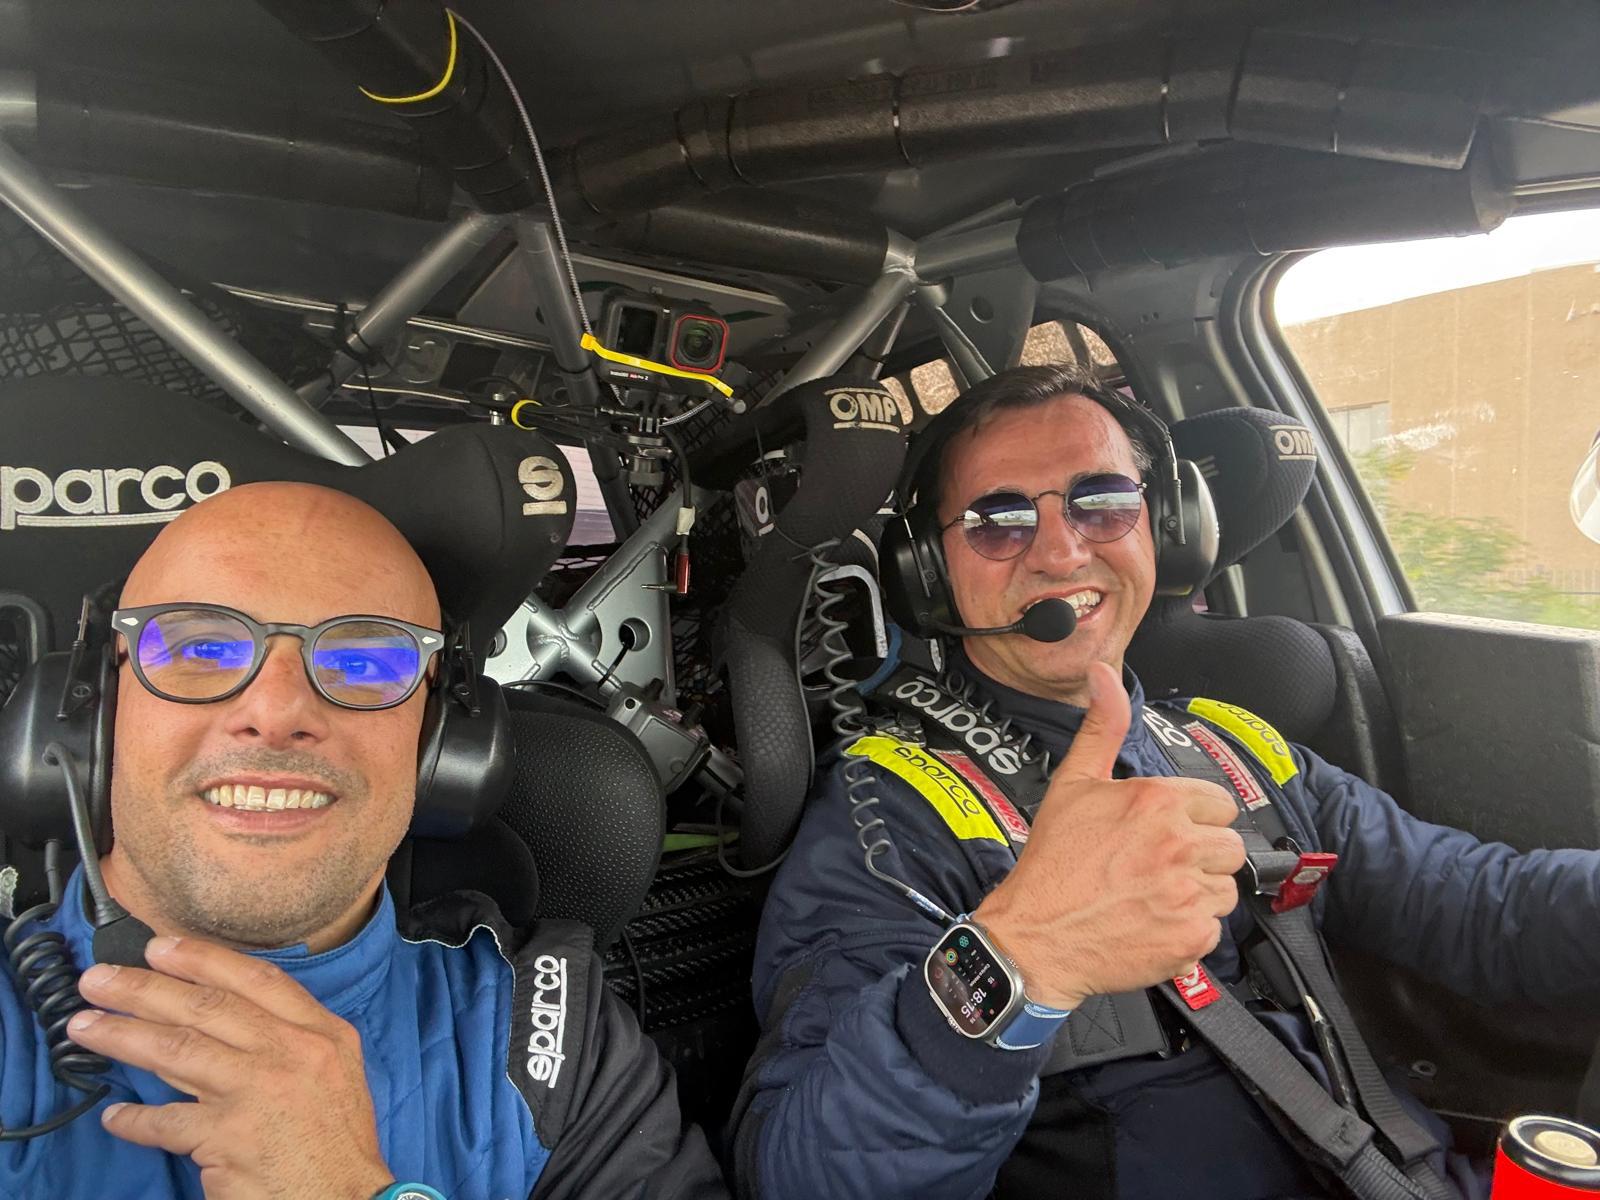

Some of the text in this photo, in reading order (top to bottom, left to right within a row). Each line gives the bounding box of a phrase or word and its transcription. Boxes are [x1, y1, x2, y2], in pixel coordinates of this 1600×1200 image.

[829, 392, 897, 423] OMP
[1275, 430, 1316, 455] OM
[0, 461, 231, 530] parco
[895, 681, 1023, 775] sparco
[526, 954, 566, 1081] sparco
[961, 988, 987, 1019] 18:15
